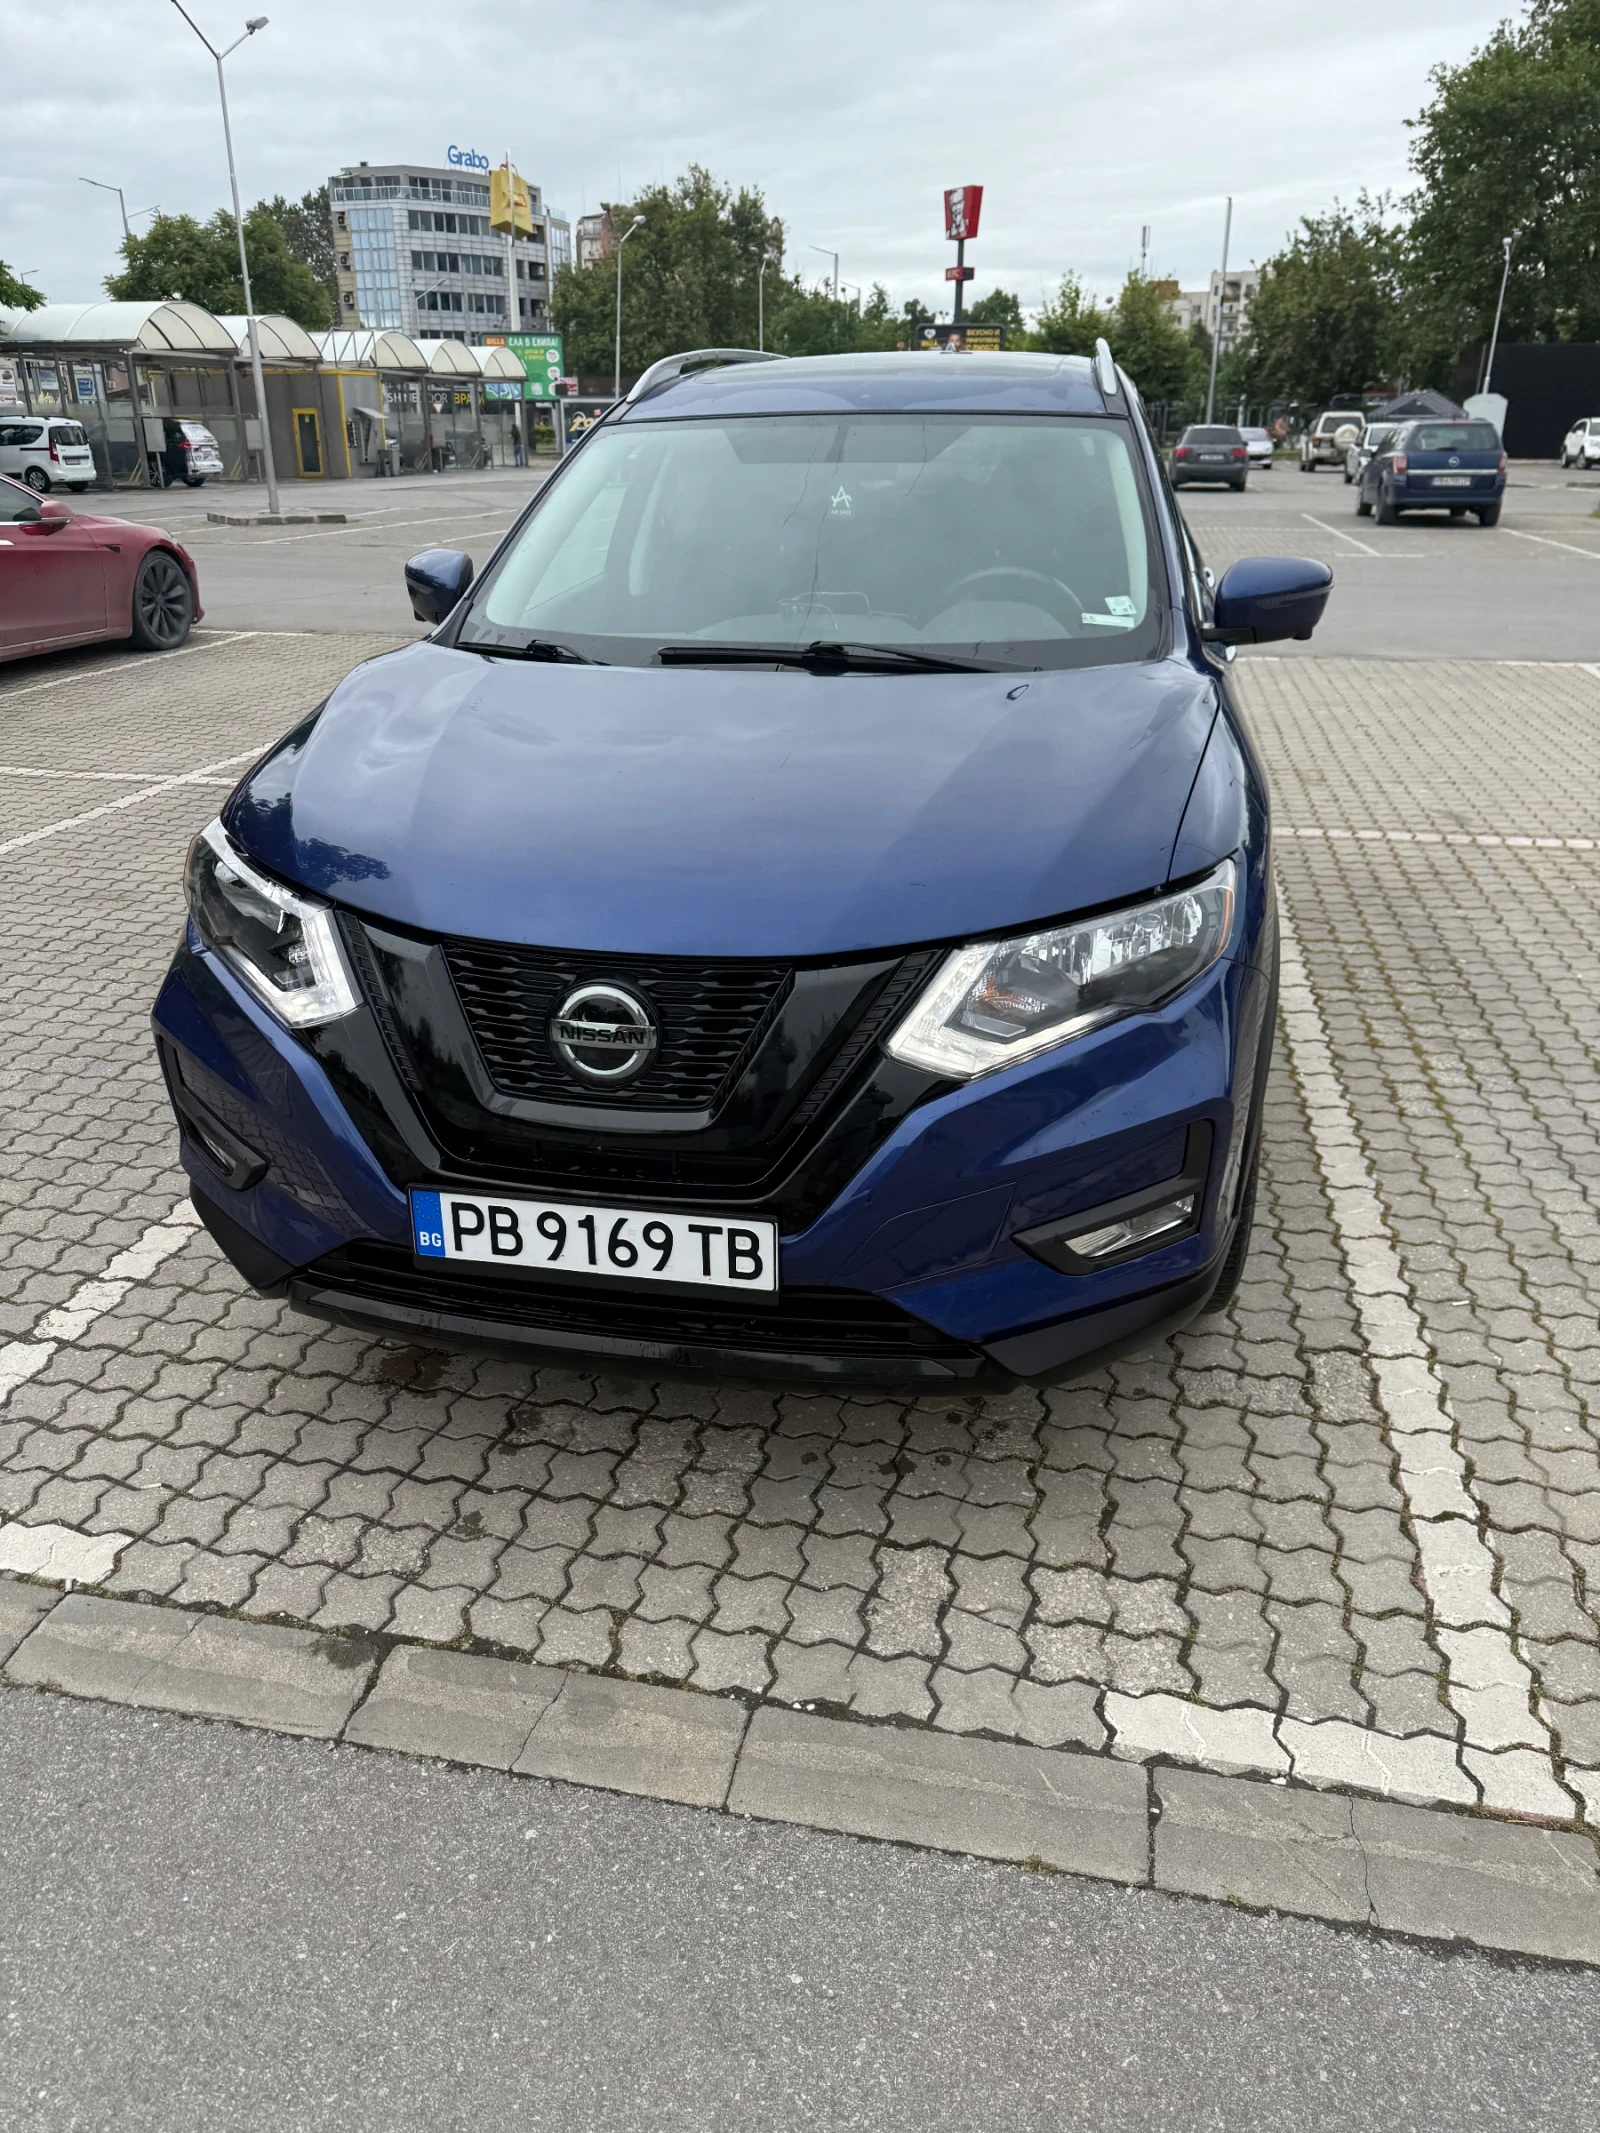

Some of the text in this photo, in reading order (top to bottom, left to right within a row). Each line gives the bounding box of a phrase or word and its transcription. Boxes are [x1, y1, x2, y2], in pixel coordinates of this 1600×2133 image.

[447, 144, 489, 170] Grabo
[454, 393, 485, 405] ВРАИ
[560, 1025, 645, 1045] NISSAN
[419, 1201, 764, 1281] BG PB 9169 TB
